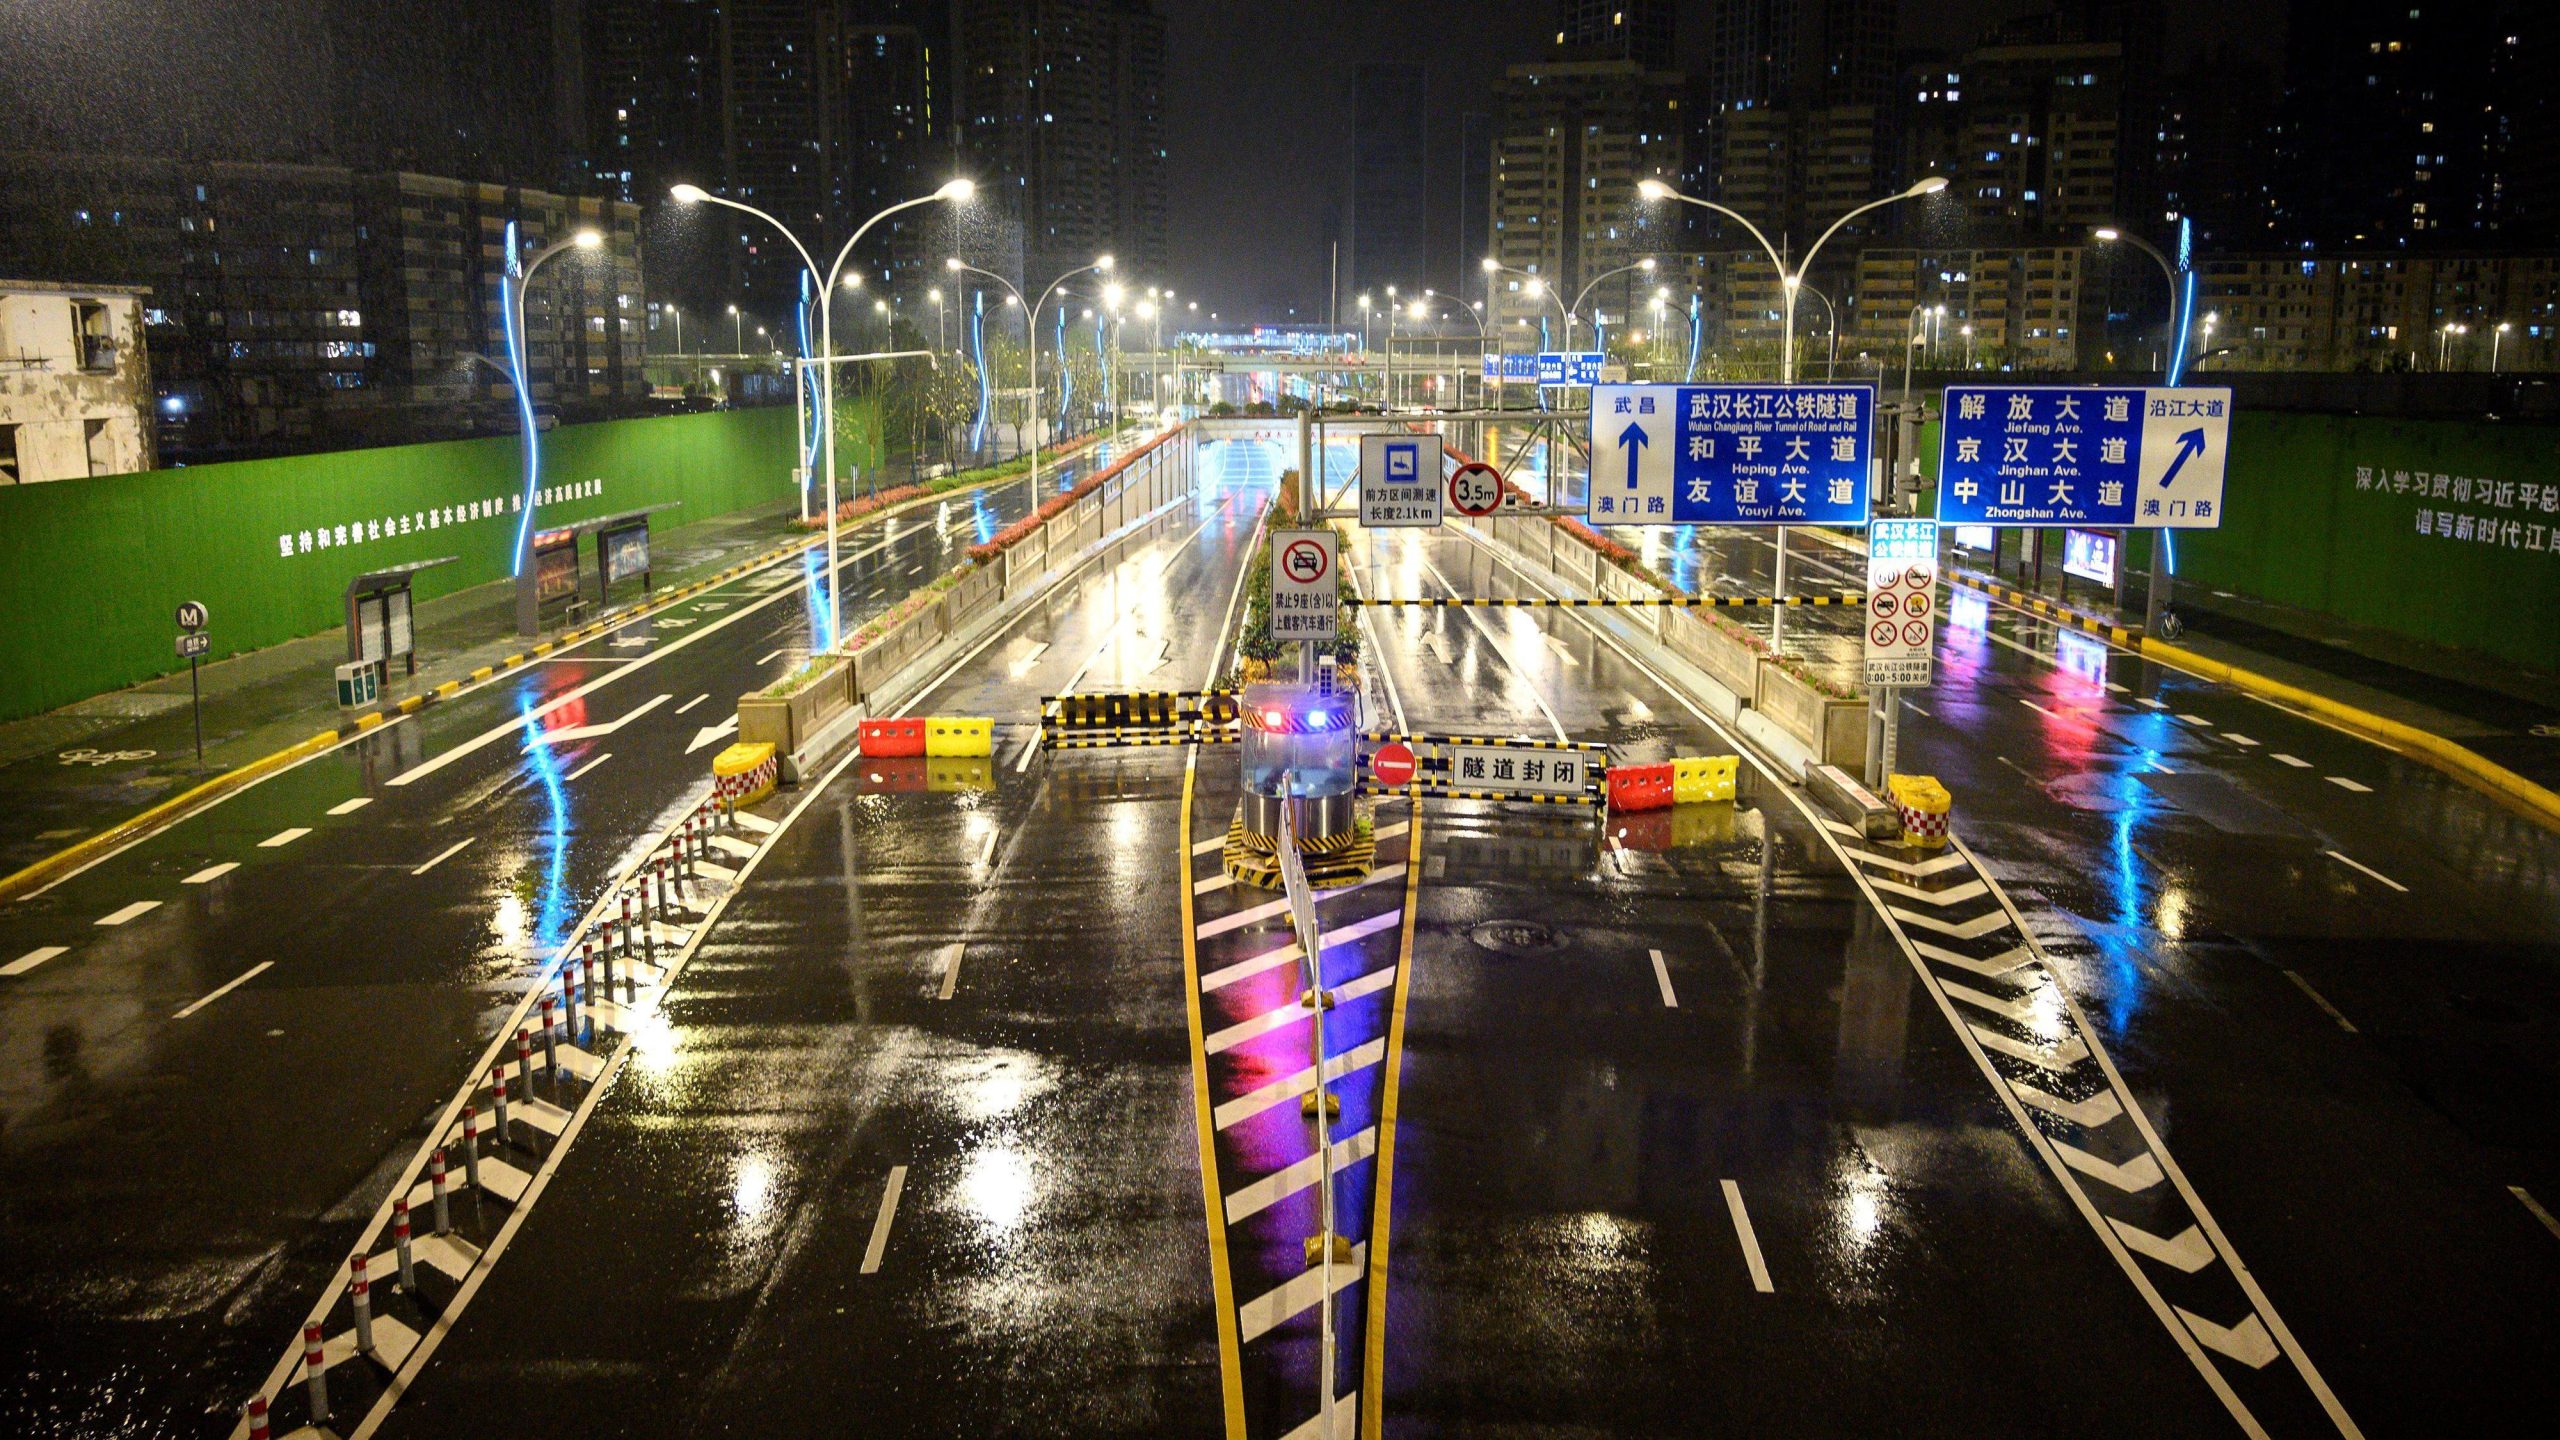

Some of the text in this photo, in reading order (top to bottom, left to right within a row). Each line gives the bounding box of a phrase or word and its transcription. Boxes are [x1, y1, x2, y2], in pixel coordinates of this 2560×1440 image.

[1614, 396, 1656, 414] 武昌
[1690, 393, 1857, 420] 武汉长江公铁隧道
[1959, 394, 2130, 422] 解放大道
[2150, 400, 2225, 417] 沿江大道
[1688, 422, 1857, 433] Wuhan Changjiang River Tunnel of Road and Rail
[2004, 422, 2083, 434] Jiefang Ave.
[1689, 436, 1857, 462] 和平大道
[1955, 437, 2127, 464] 京汉大道
[1732, 463, 1810, 477] Heping Ave.
[1998, 465, 2081, 477] Jinghan Ave.
[512, 478, 602, 513] 推经济高质量发展
[1365, 487, 1437, 502] 前方区间测速
[1458, 479, 1495, 501] 3.5m
[1687, 478, 1854, 504] 友谊大道
[1953, 478, 2124, 506] 中山大道
[2356, 466, 2560, 513] 深入学习贯彻习近平总
[1370, 506, 1432, 521] 长度2.1km
[1597, 496, 1665, 514] 澳门路
[1737, 505, 1806, 519] Youyi Ave.
[1985, 506, 2087, 520] Zhongshan Ave.
[2143, 499, 2213, 517] 澳门路
[1275, 592, 1334, 609] 禁止9座(含)以
[1274, 614, 1334, 631] 上载客汽车通行
[1462, 756, 1575, 784] 隧道封闭
